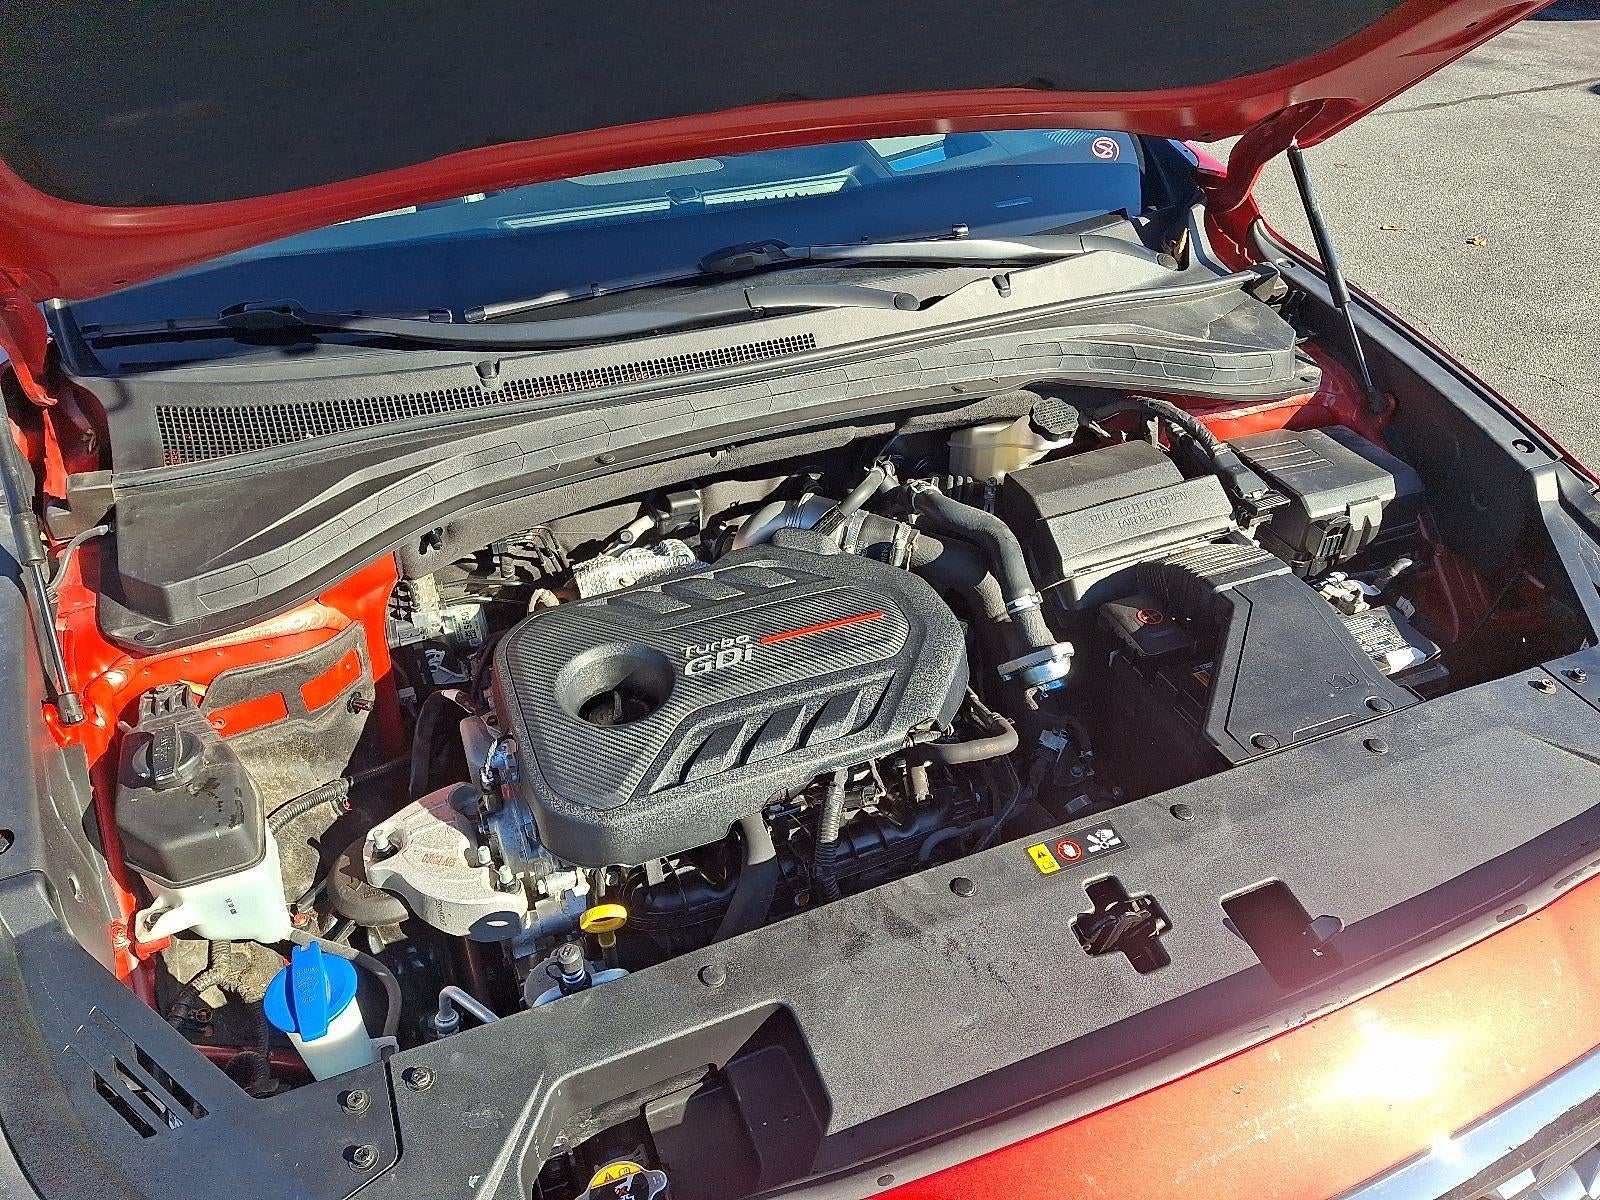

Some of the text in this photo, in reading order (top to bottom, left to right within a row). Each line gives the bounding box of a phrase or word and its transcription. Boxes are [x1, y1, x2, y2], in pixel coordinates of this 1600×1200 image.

[1089, 490, 1188, 524] PULL OUT TO OPEN
[684, 643, 754, 675] GDi
